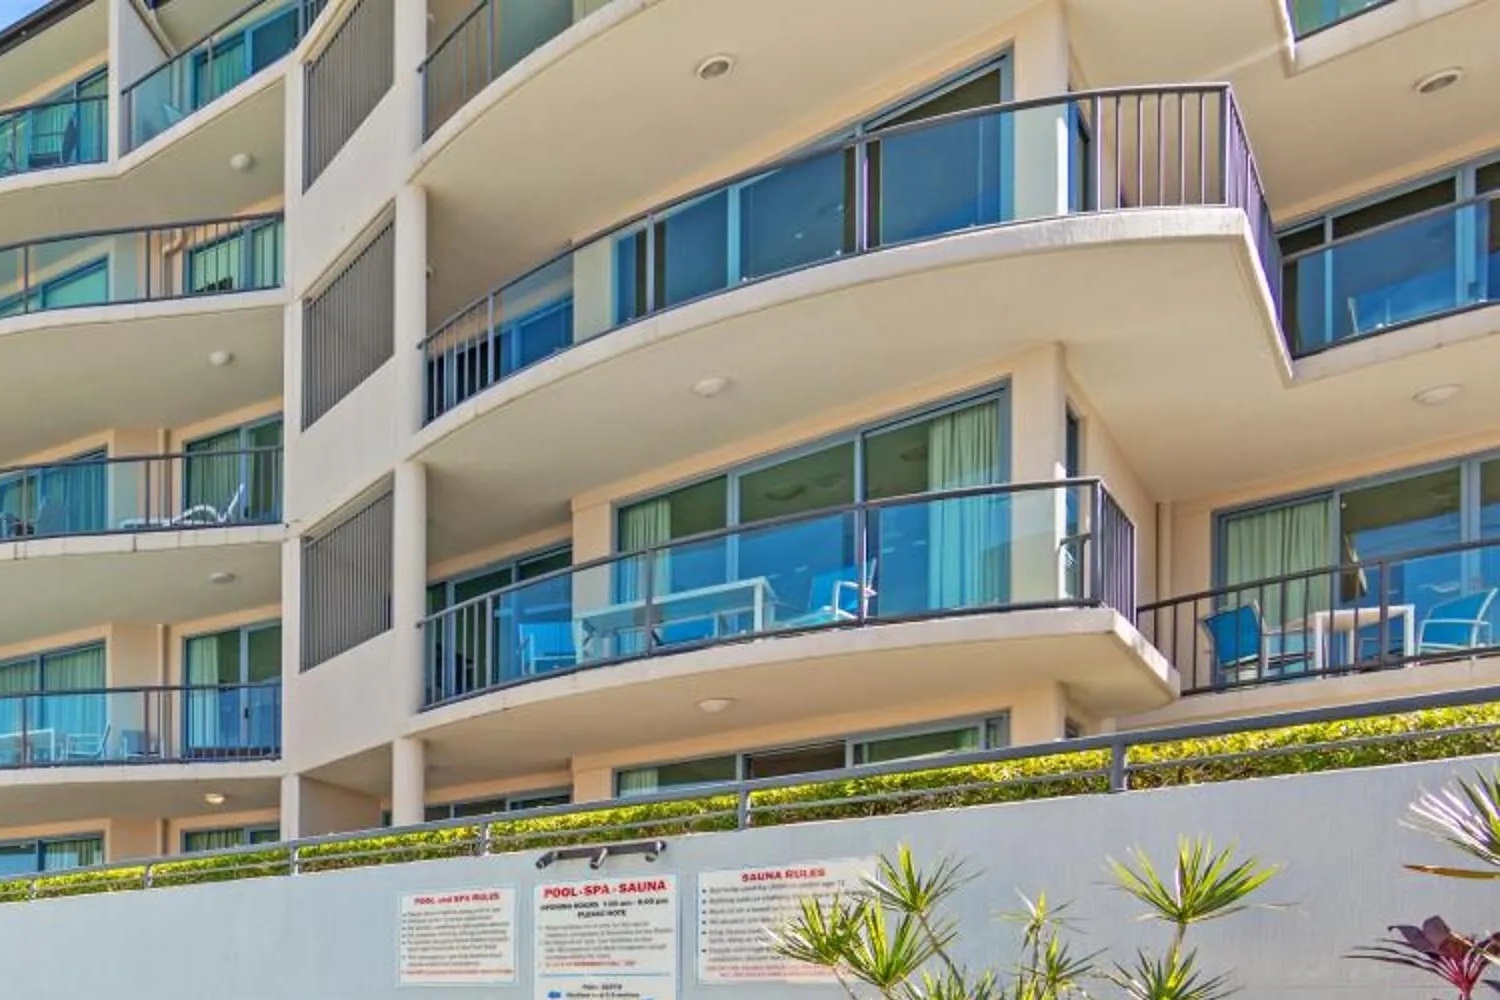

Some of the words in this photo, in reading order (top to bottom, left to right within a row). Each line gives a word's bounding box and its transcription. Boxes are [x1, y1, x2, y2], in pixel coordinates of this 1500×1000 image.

[741, 871, 783, 883] SAUNA
[785, 867, 827, 879] RULES
[544, 887, 577, 898] POOL
[583, 885, 610, 897] SPA
[619, 880, 667, 894] SAUNA
[413, 896, 435, 905] POOL
[453, 894, 471, 904] SPA
[471, 891, 501, 902] RULES
